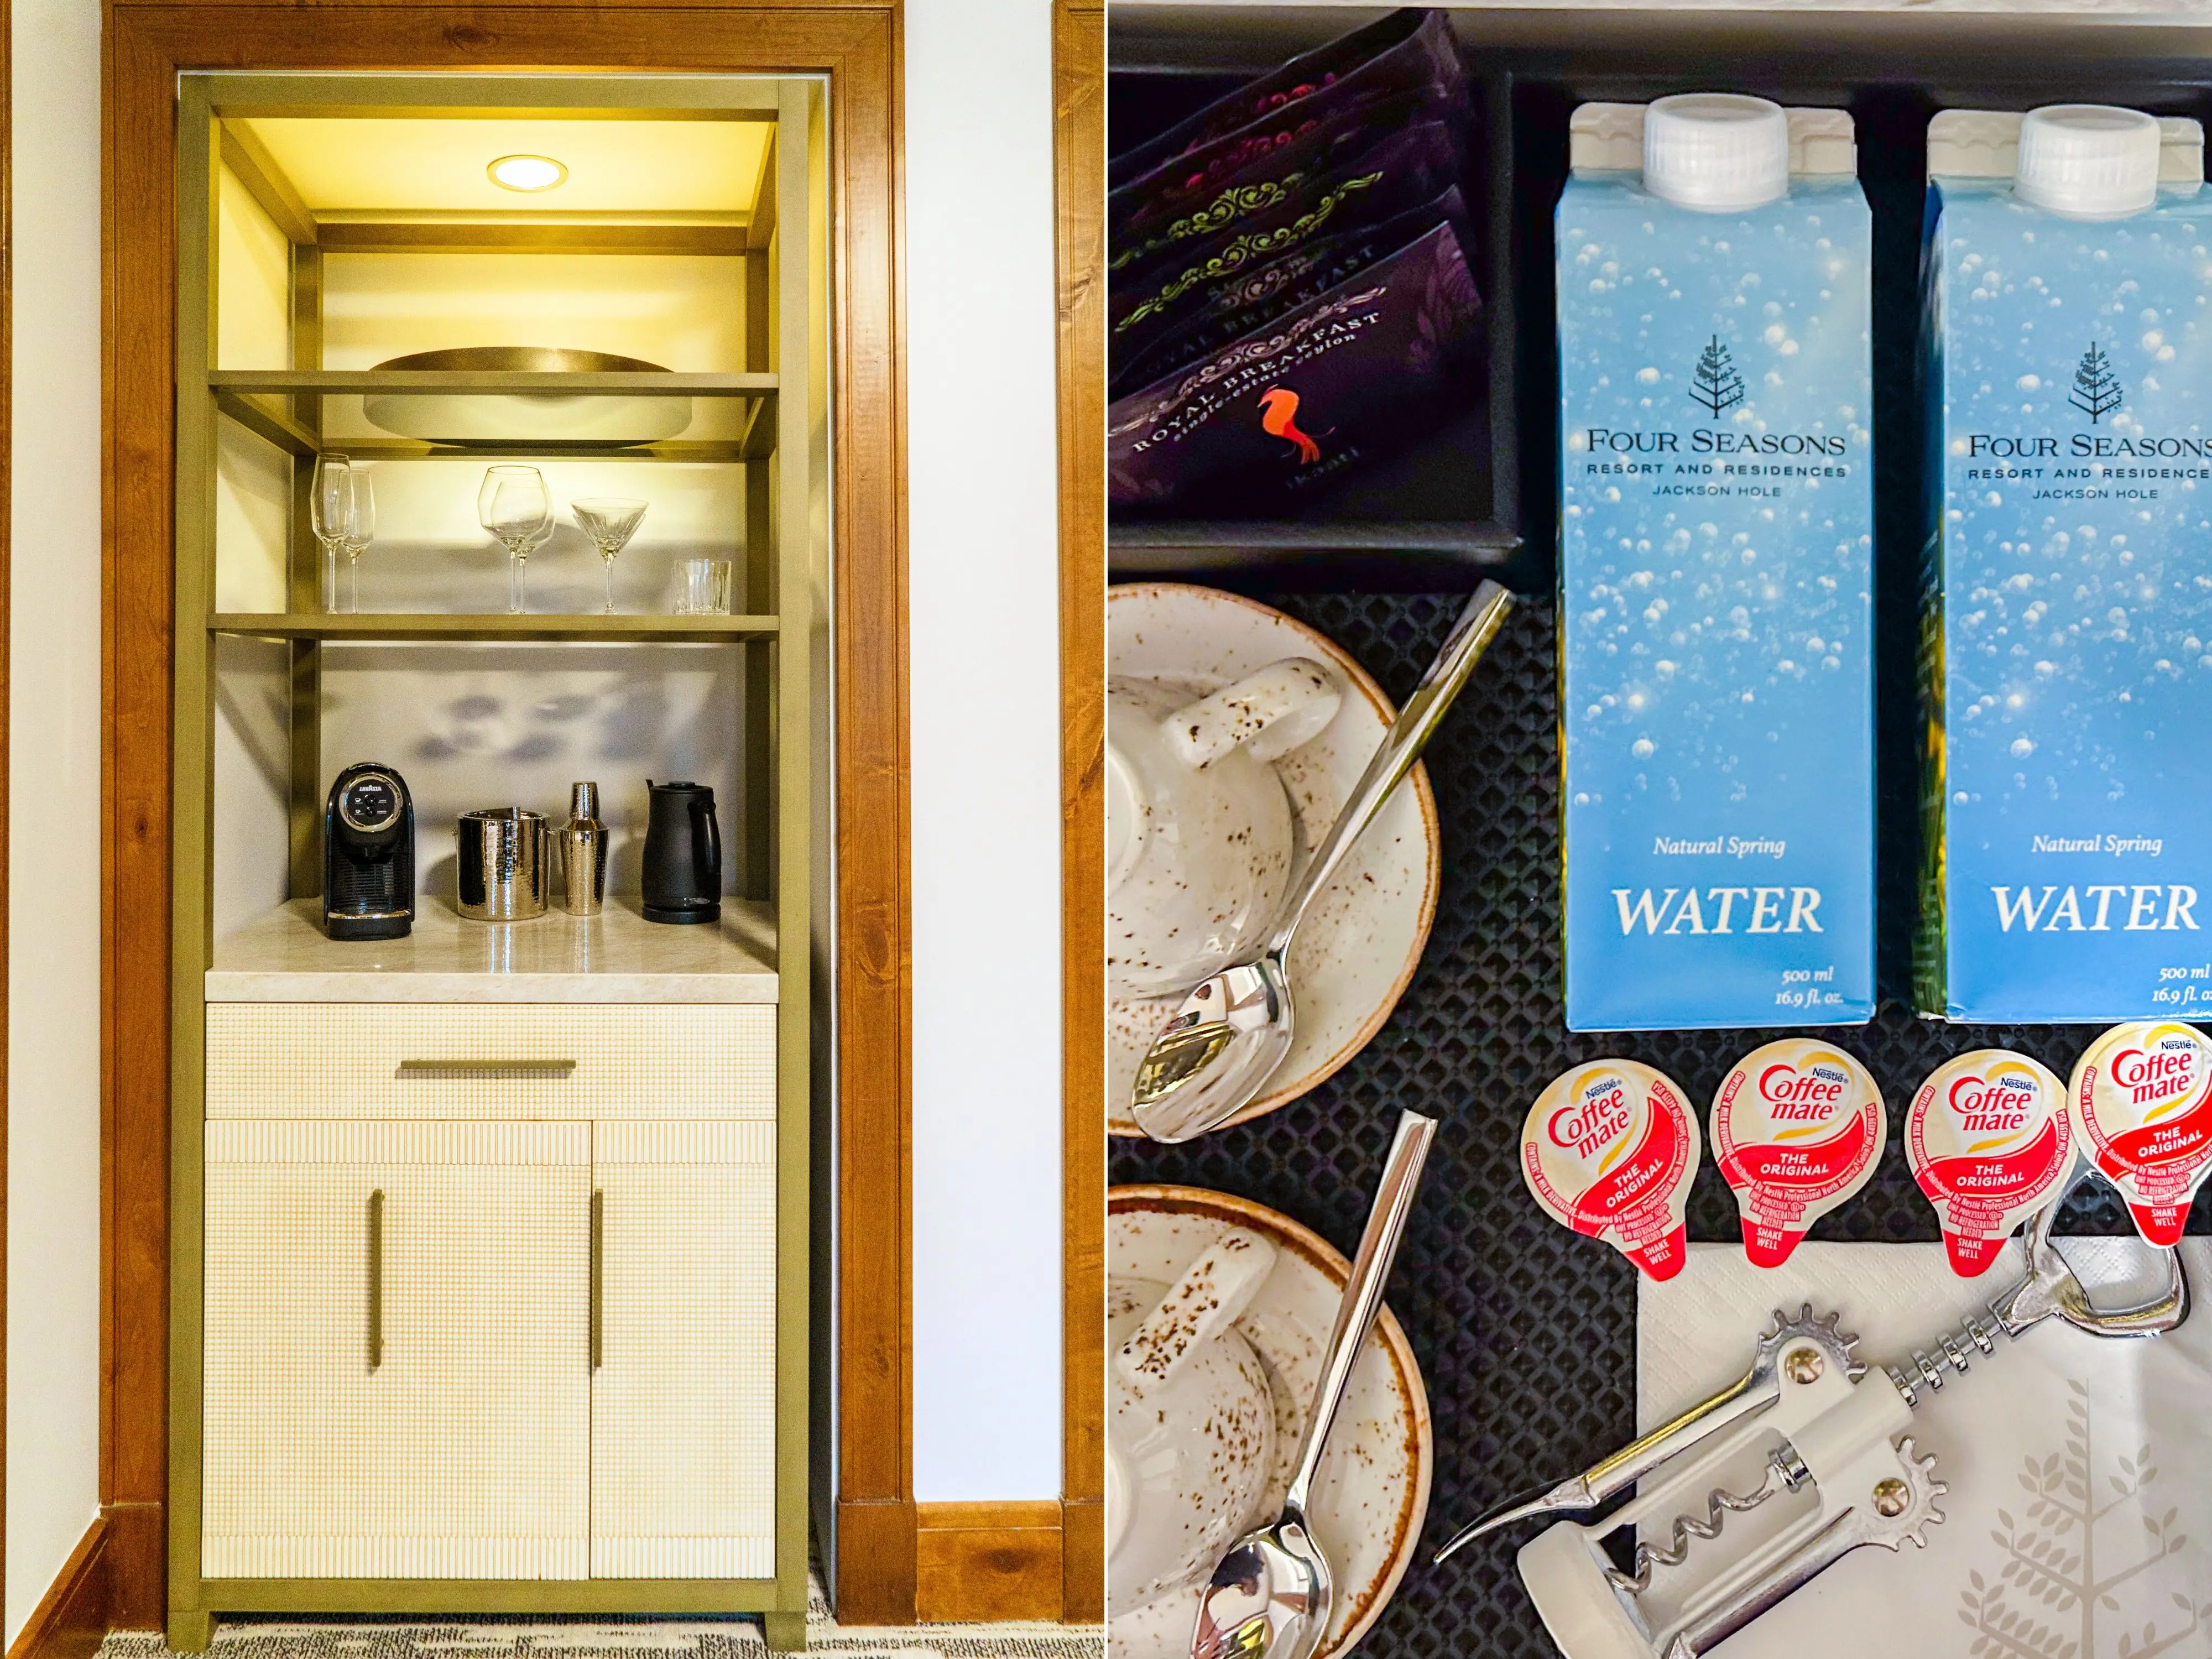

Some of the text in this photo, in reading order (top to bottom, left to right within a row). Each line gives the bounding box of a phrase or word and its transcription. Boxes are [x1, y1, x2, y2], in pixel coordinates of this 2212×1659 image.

[1133, 311, 1379, 452] ROYAL BREAKFAST
[1587, 429, 1846, 456] FOUR SEASONS
[1969, 435, 2059, 457] FOUR
[1587, 463, 1846, 478] RESORT AND RESIDENCES
[1968, 468, 2212, 479] RESORT AND RESIDENCE
[1652, 485, 1782, 497] JACKSON HOLE
[2032, 489, 2158, 499] JACKSON HOLE
[1653, 835, 1787, 859] Natural Spring
[2031, 834, 2163, 857] Natural Spring
[1610, 886, 1825, 936] WATER
[1990, 885, 2201, 933] WATER
[1782, 965, 1834, 985] 500 ml
[2158, 963, 2211, 983] 500 ml
[1775, 990, 1804, 1008] 16.9
[1804, 988, 1821, 1009] fl.
[2152, 987, 2180, 1005] 16.9
[2180, 985, 2198, 1006] fl.
[2111, 1048, 2192, 1088] Coffee
[1759, 1064, 1842, 1102] Coffee
[2132, 1075, 2190, 1104] mate
[1948, 1076, 2032, 1114] Coffee
[1548, 1089, 1624, 1148] Coffee
[1770, 1102, 1833, 1120] mate
[1963, 1113, 2025, 1131] mate
[1578, 1110, 1629, 1160] mate
[2138, 1129, 2203, 1157] ORIGINAL
[2153, 1126, 2181, 1142] THE
[1780, 1153, 1809, 1164] THE
[2106, 1148, 2138, 1172] Distributed
[2138, 1165, 2147, 1175] By
[2168, 1154, 2203, 1175] Professional
[1613, 1163, 1641, 1188] THE
[1760, 1163, 1829, 1176] ORIGINAL
[1956, 1172, 2025, 1187] ORIGINAL
[1975, 1164, 2004, 1176] THE
[1606, 1159, 1663, 1208] ORIGINAL
[1783, 1190, 1822, 1202] Professional
[1952, 1193, 1961, 1203] By
[1981, 1197, 2018, 1211] Professional
[2018, 1188, 2036, 1203] North
[1759, 1207, 1801, 1221] REFRIGERATION
[2151, 1207, 2177, 1217] SHAKE
[2153, 1217, 2176, 1227] WELL
[1958, 1216, 1999, 1229] REFRIGERATION
[1756, 1227, 1783, 1241] SHAKE
[1756, 1237, 1778, 1250] WELL
[1957, 1238, 1983, 1250] SHAKE
[1643, 1238, 1670, 1258] SHAKE
[1648, 1249, 1672, 1265] WELL
[1958, 1247, 1979, 1259] WELL
